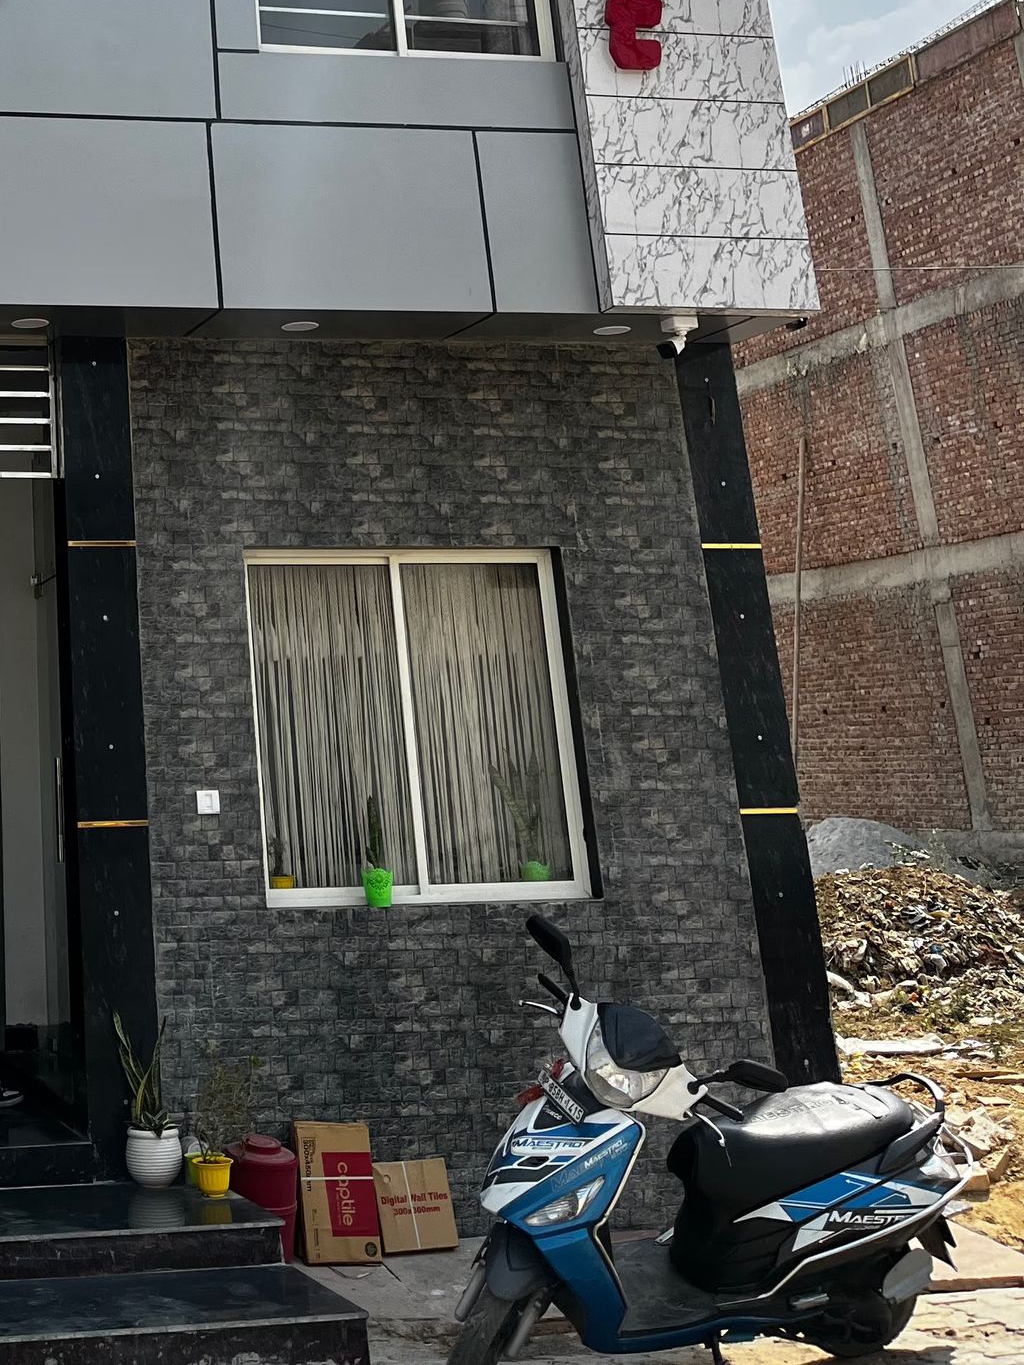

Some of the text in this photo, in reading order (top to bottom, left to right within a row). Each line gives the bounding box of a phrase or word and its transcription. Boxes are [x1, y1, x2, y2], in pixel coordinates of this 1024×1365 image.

[751, 1098, 835, 1124] AESTRO
[516, 1138, 583, 1150] MAESTRO
[336, 1162, 356, 1226] captile
[380, 1195, 407, 1207] Digital
[427, 1191, 448, 1201] Tiles
[829, 1210, 913, 1226] MAESTR
